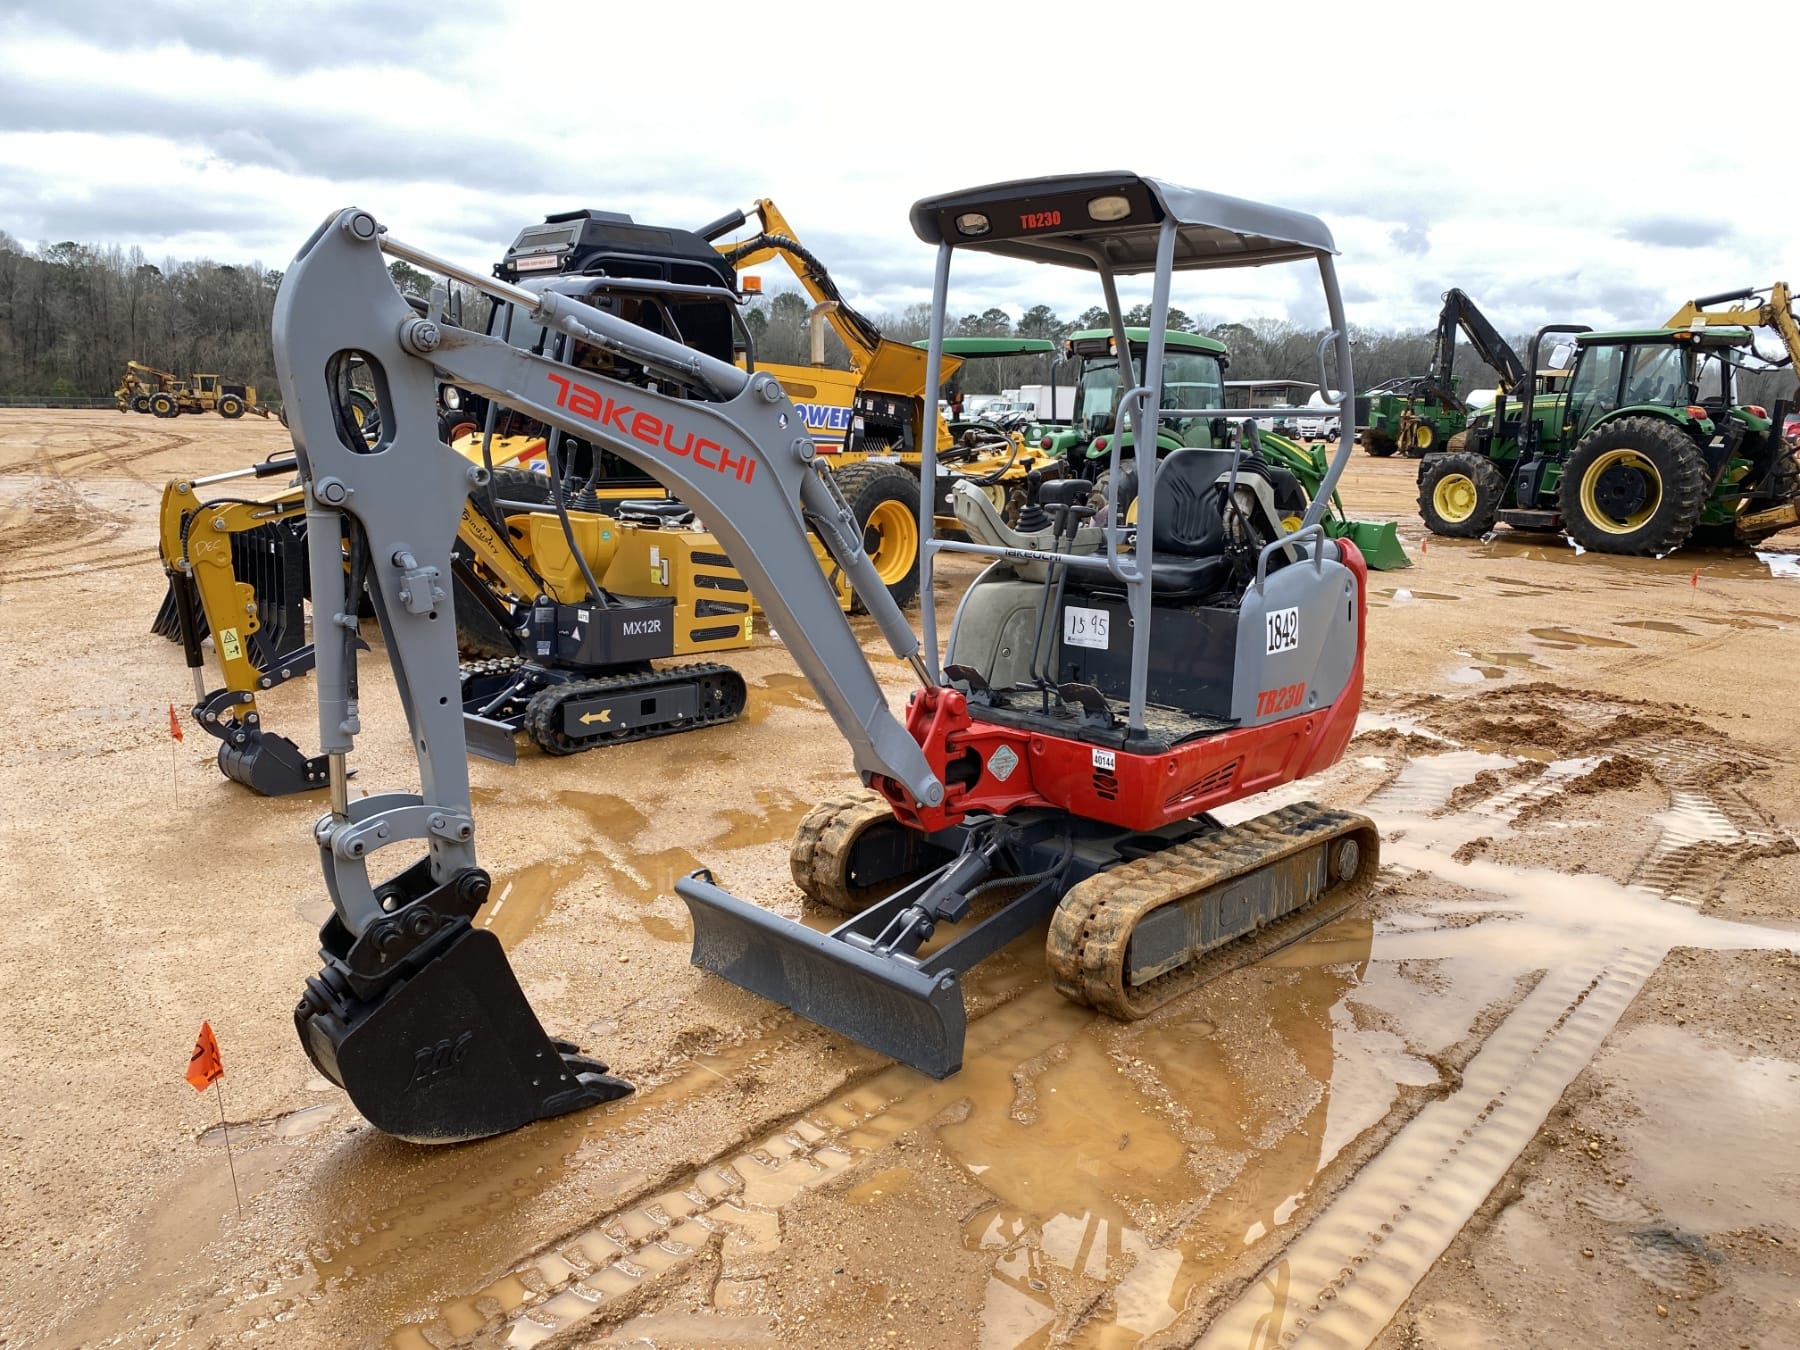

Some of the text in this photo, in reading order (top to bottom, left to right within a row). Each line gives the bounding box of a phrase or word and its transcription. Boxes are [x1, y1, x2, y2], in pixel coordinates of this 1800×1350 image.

[1020, 210, 1061, 230] TB230
[793, 402, 852, 429] OWER
[623, 620, 662, 636] MX12R
[1268, 611, 1297, 651] 1842
[1255, 682, 1306, 717] TB230
[1094, 754, 1114, 768] 40144
